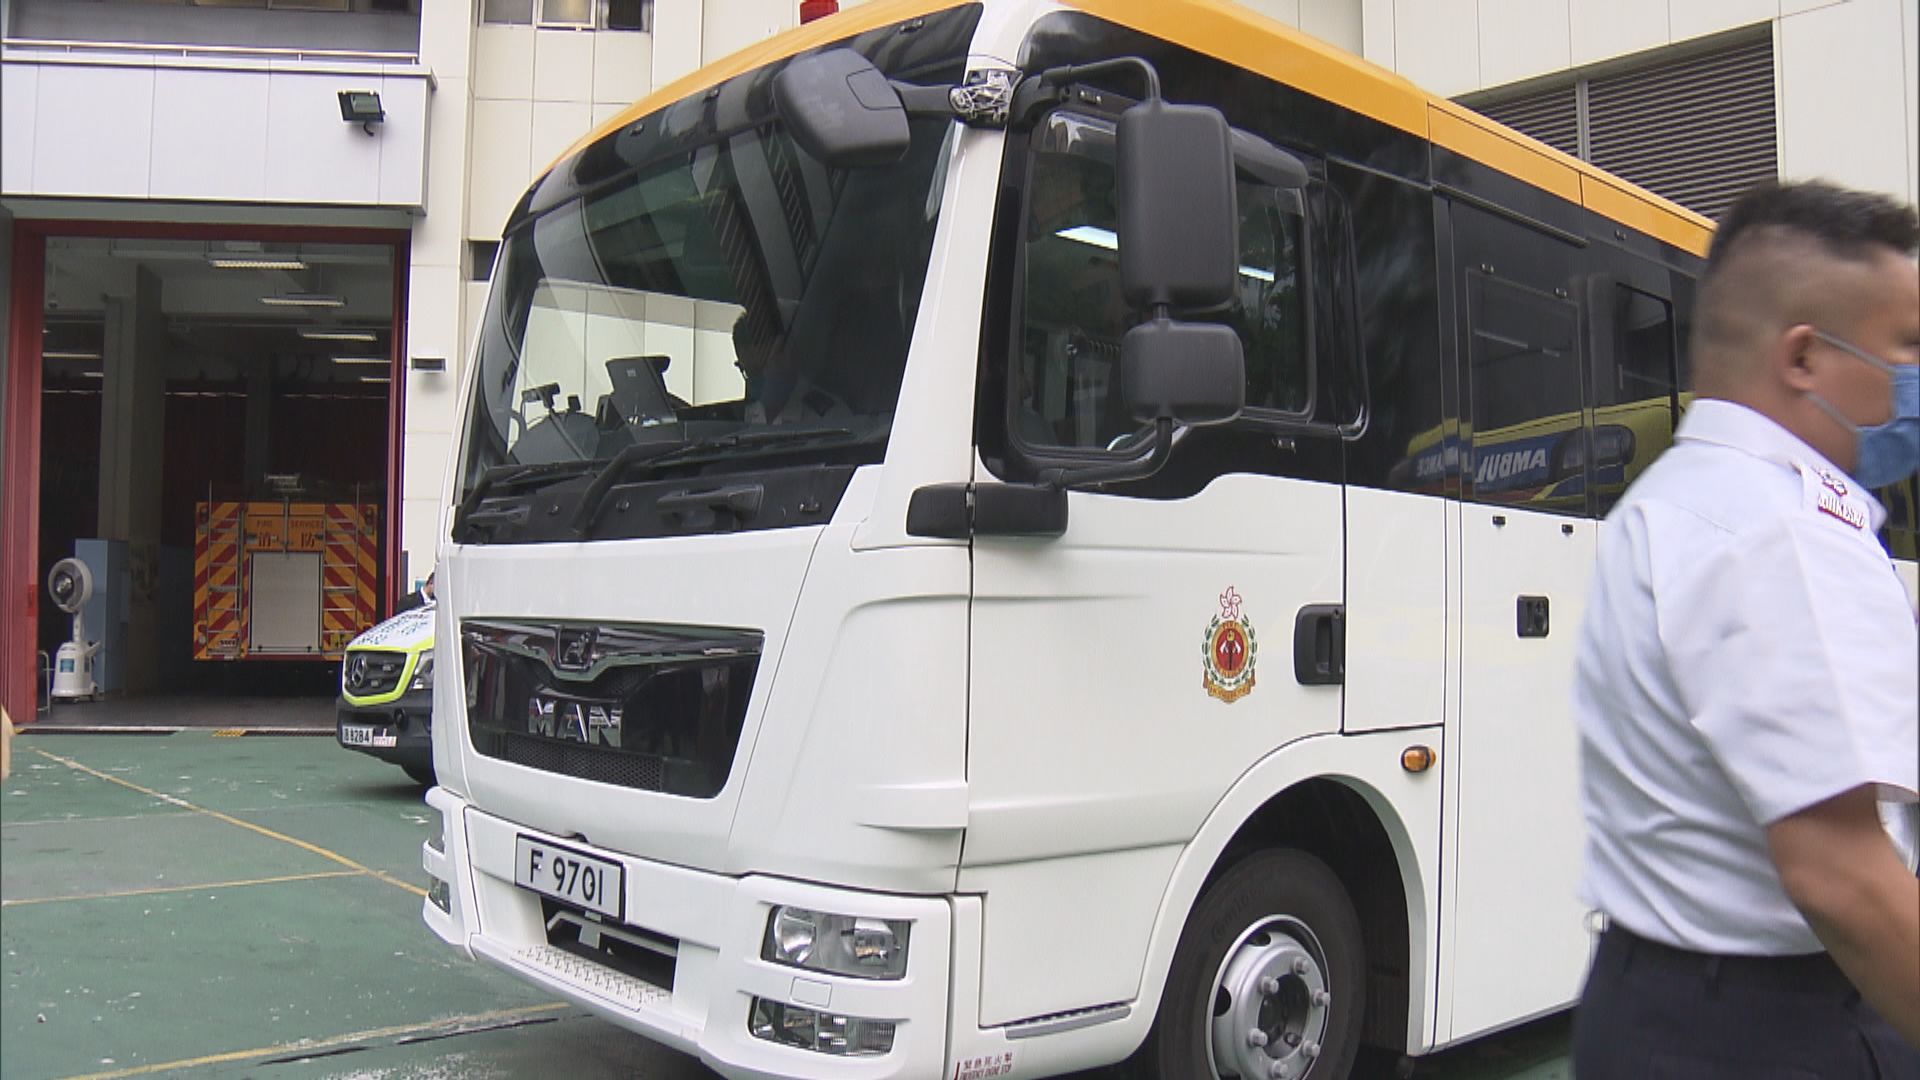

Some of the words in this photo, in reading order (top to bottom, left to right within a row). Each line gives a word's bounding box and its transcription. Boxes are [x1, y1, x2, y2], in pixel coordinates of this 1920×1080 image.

[528, 697, 622, 747] MAN
[530, 848, 543, 883] F
[553, 856, 603, 905] 9701
